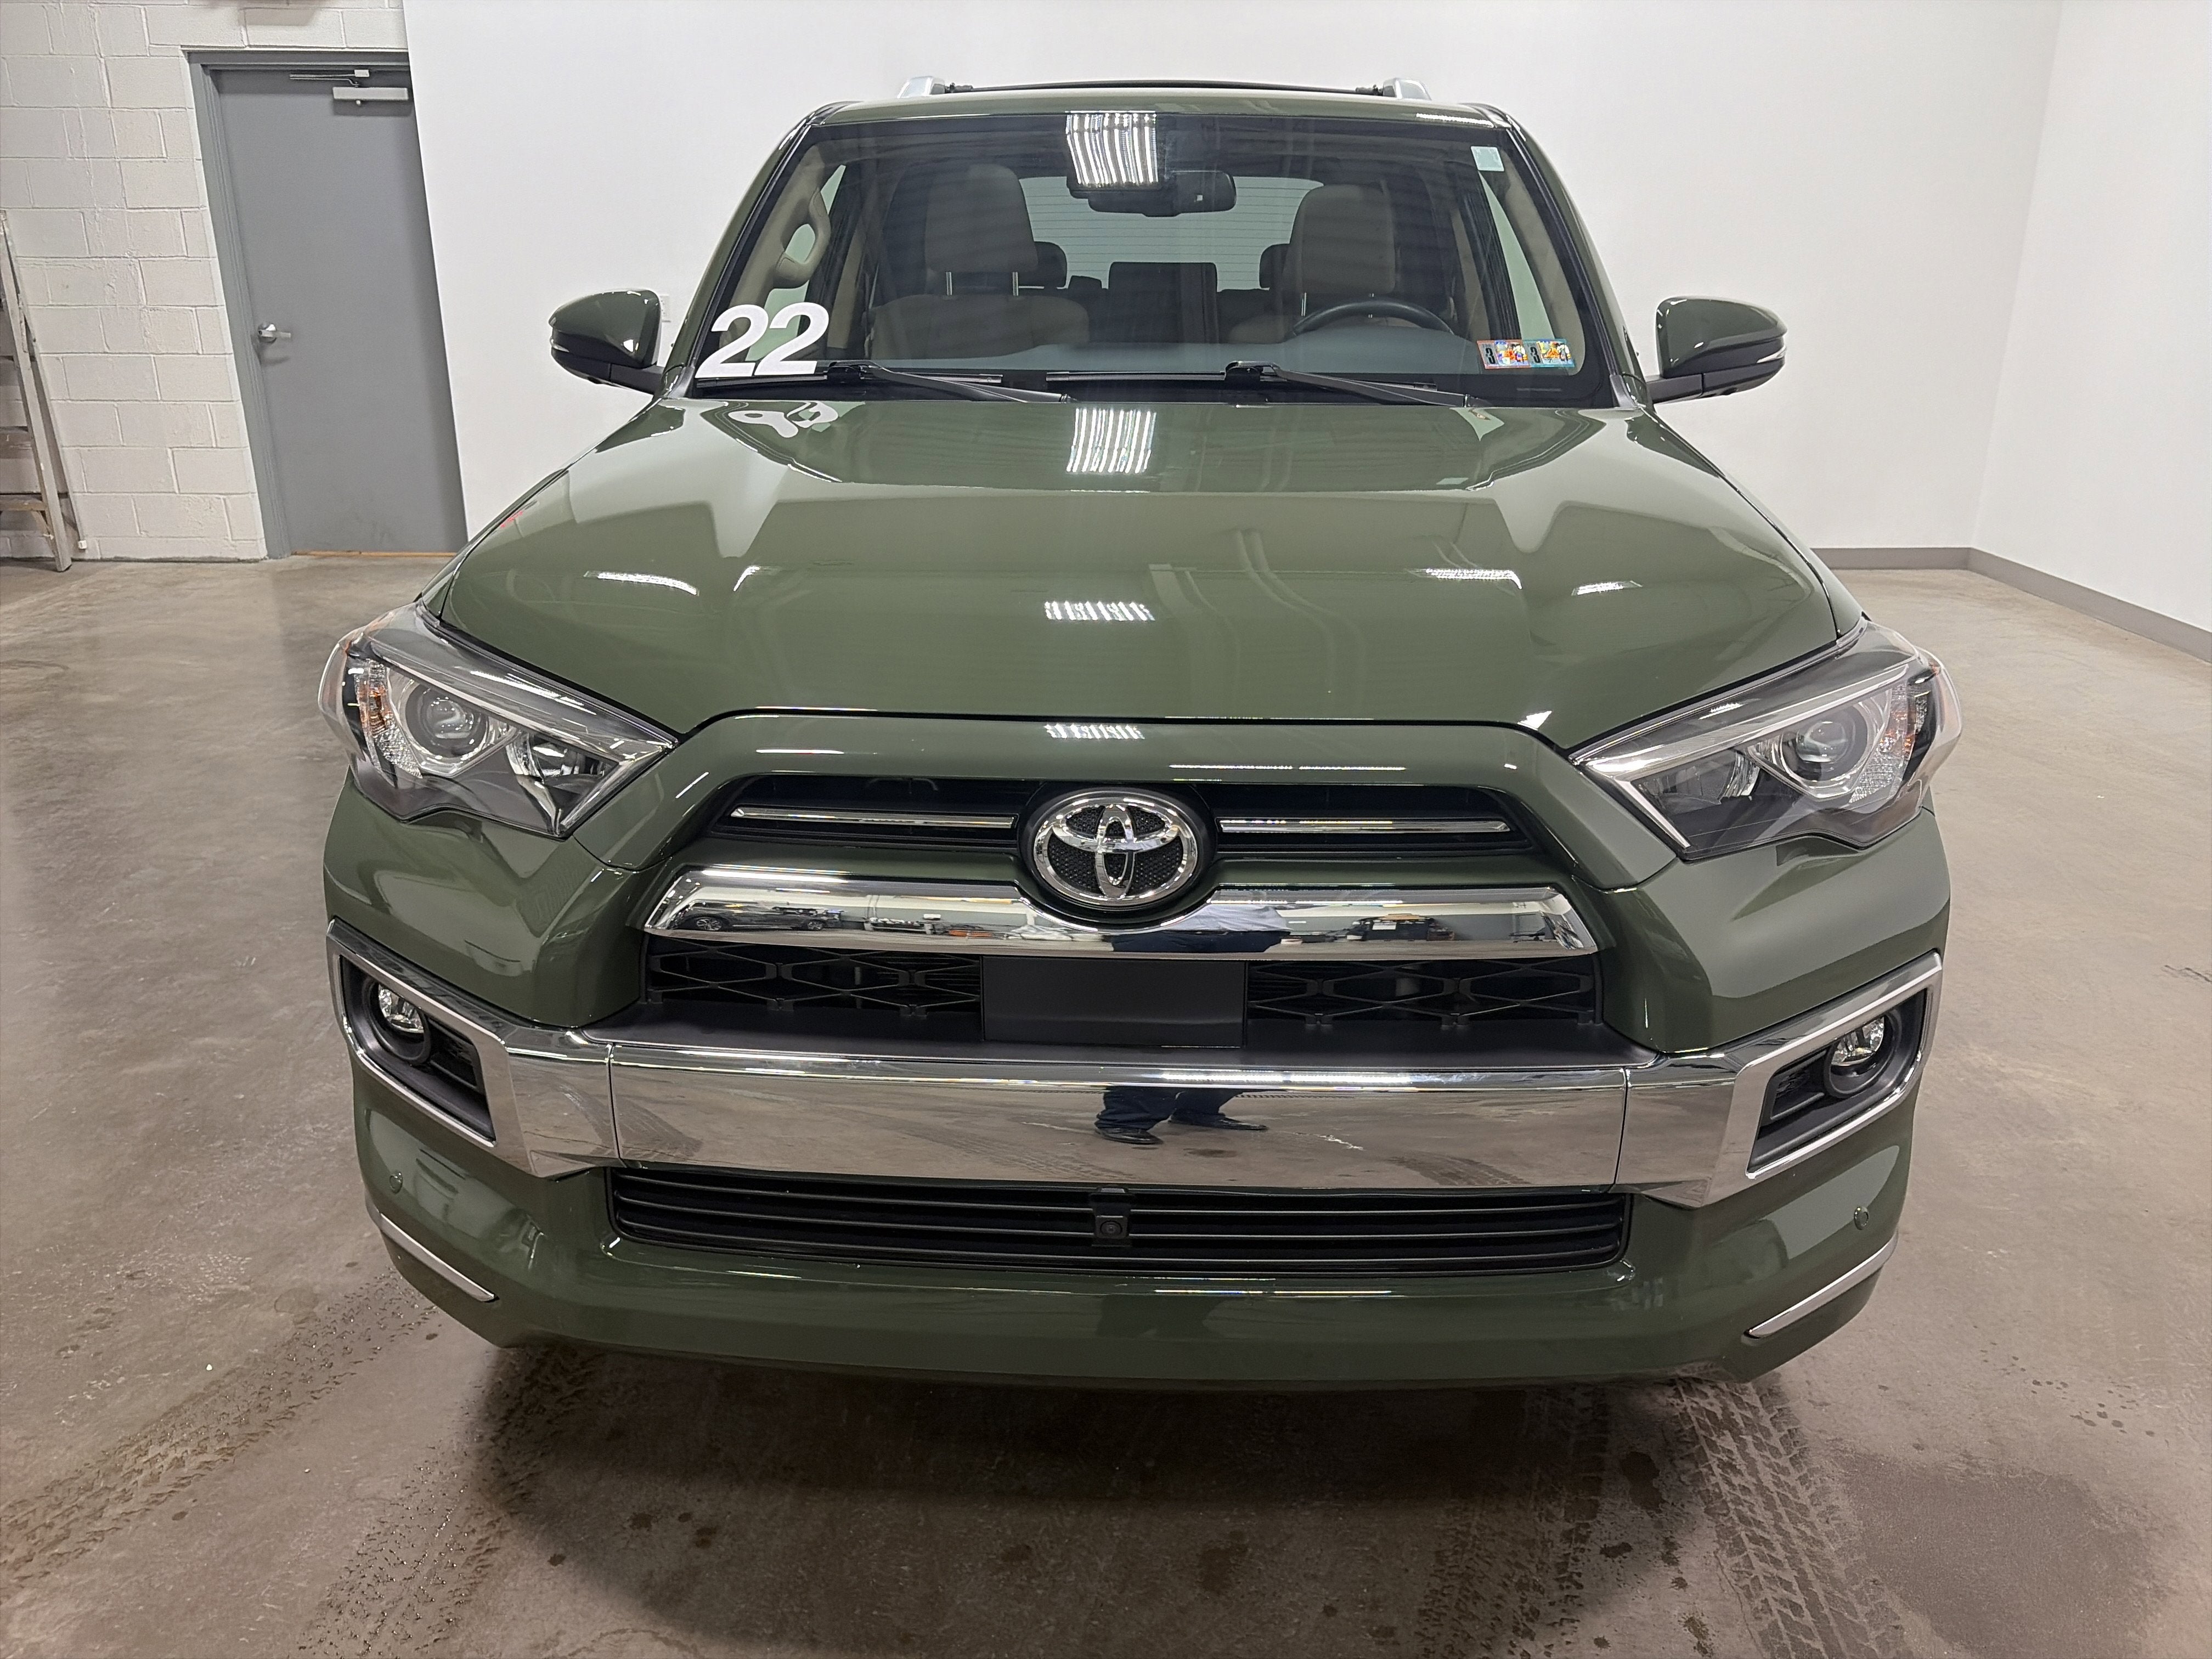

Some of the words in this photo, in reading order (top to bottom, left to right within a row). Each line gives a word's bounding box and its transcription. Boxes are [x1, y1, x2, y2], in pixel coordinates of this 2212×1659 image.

[695, 302, 830, 378] 22
[1485, 347, 1496, 364] 3
[1530, 347, 1541, 363] 3
